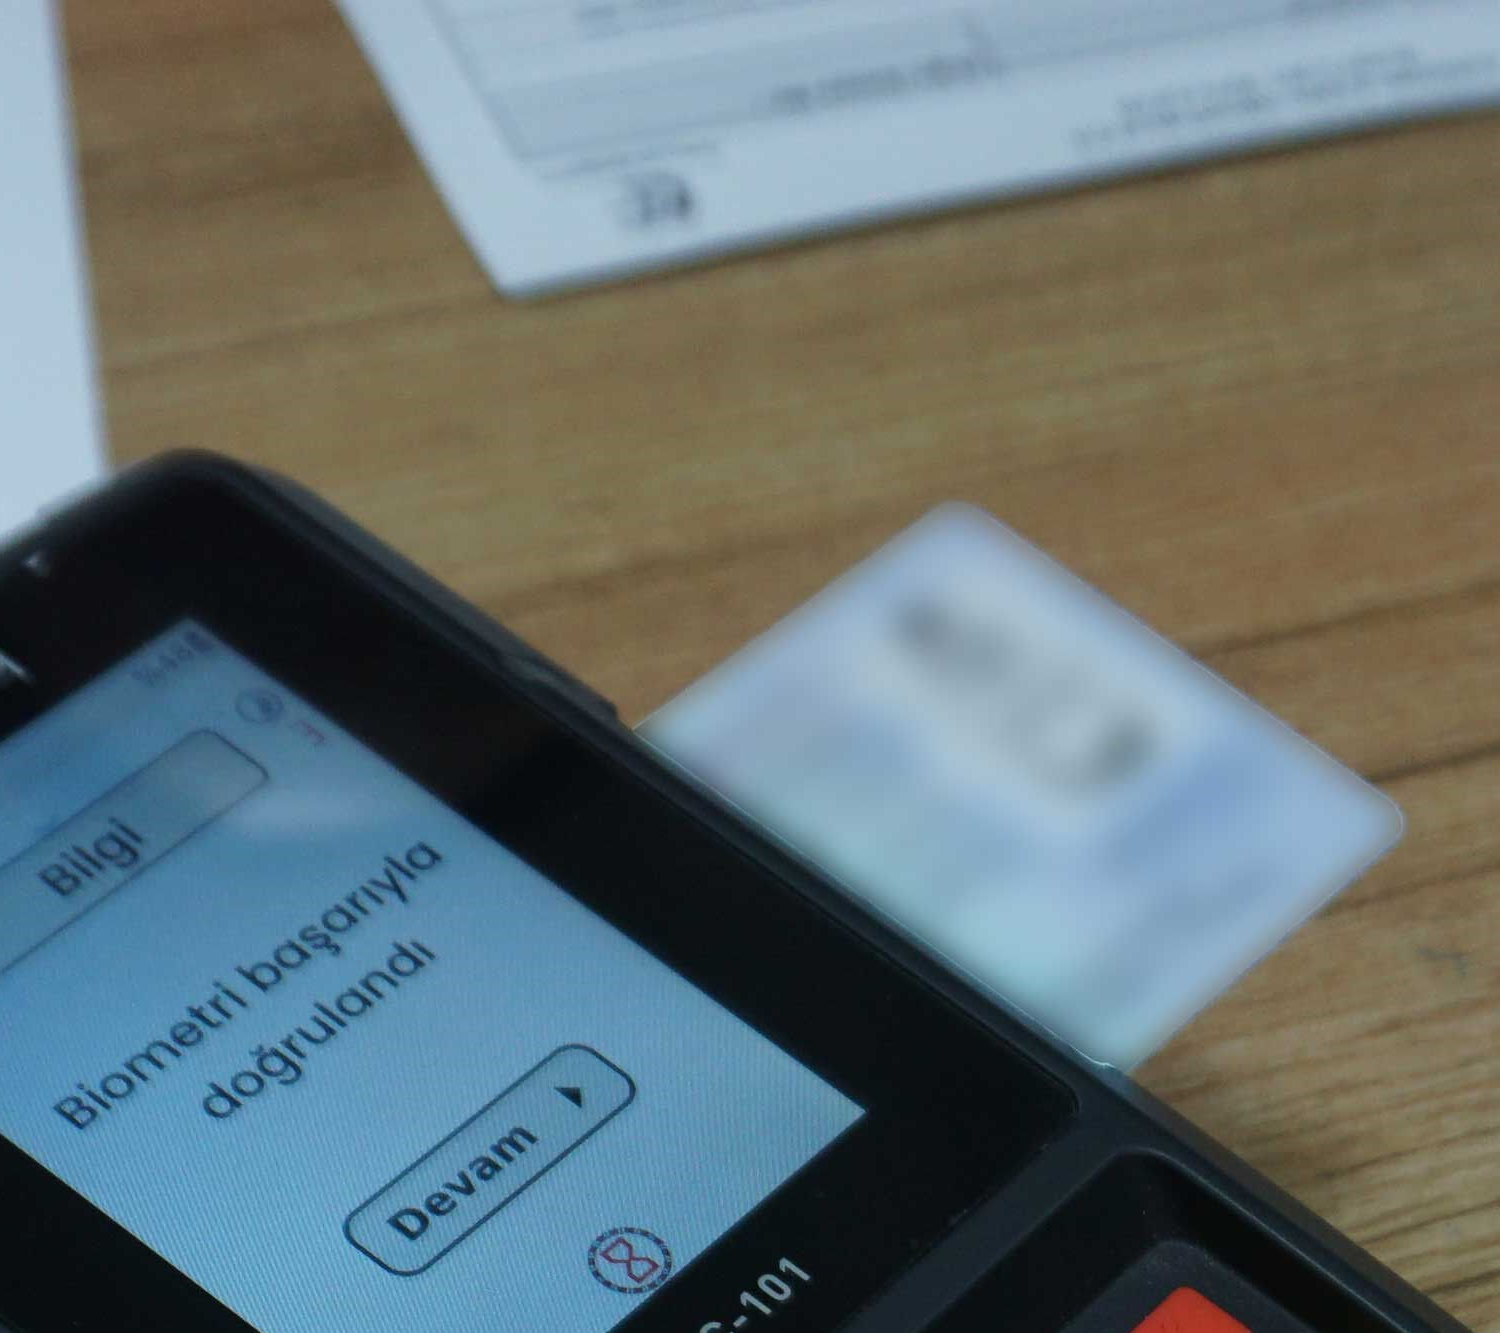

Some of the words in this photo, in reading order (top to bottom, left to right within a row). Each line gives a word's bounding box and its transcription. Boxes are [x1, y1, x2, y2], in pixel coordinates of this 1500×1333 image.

[38, 816, 143, 897] Bilgi
[52, 981, 249, 1131] Biometri
[235, 840, 443, 994] başarıyla
[202, 938, 438, 1120] doğrulandı
[386, 1120, 539, 1242] Devam
